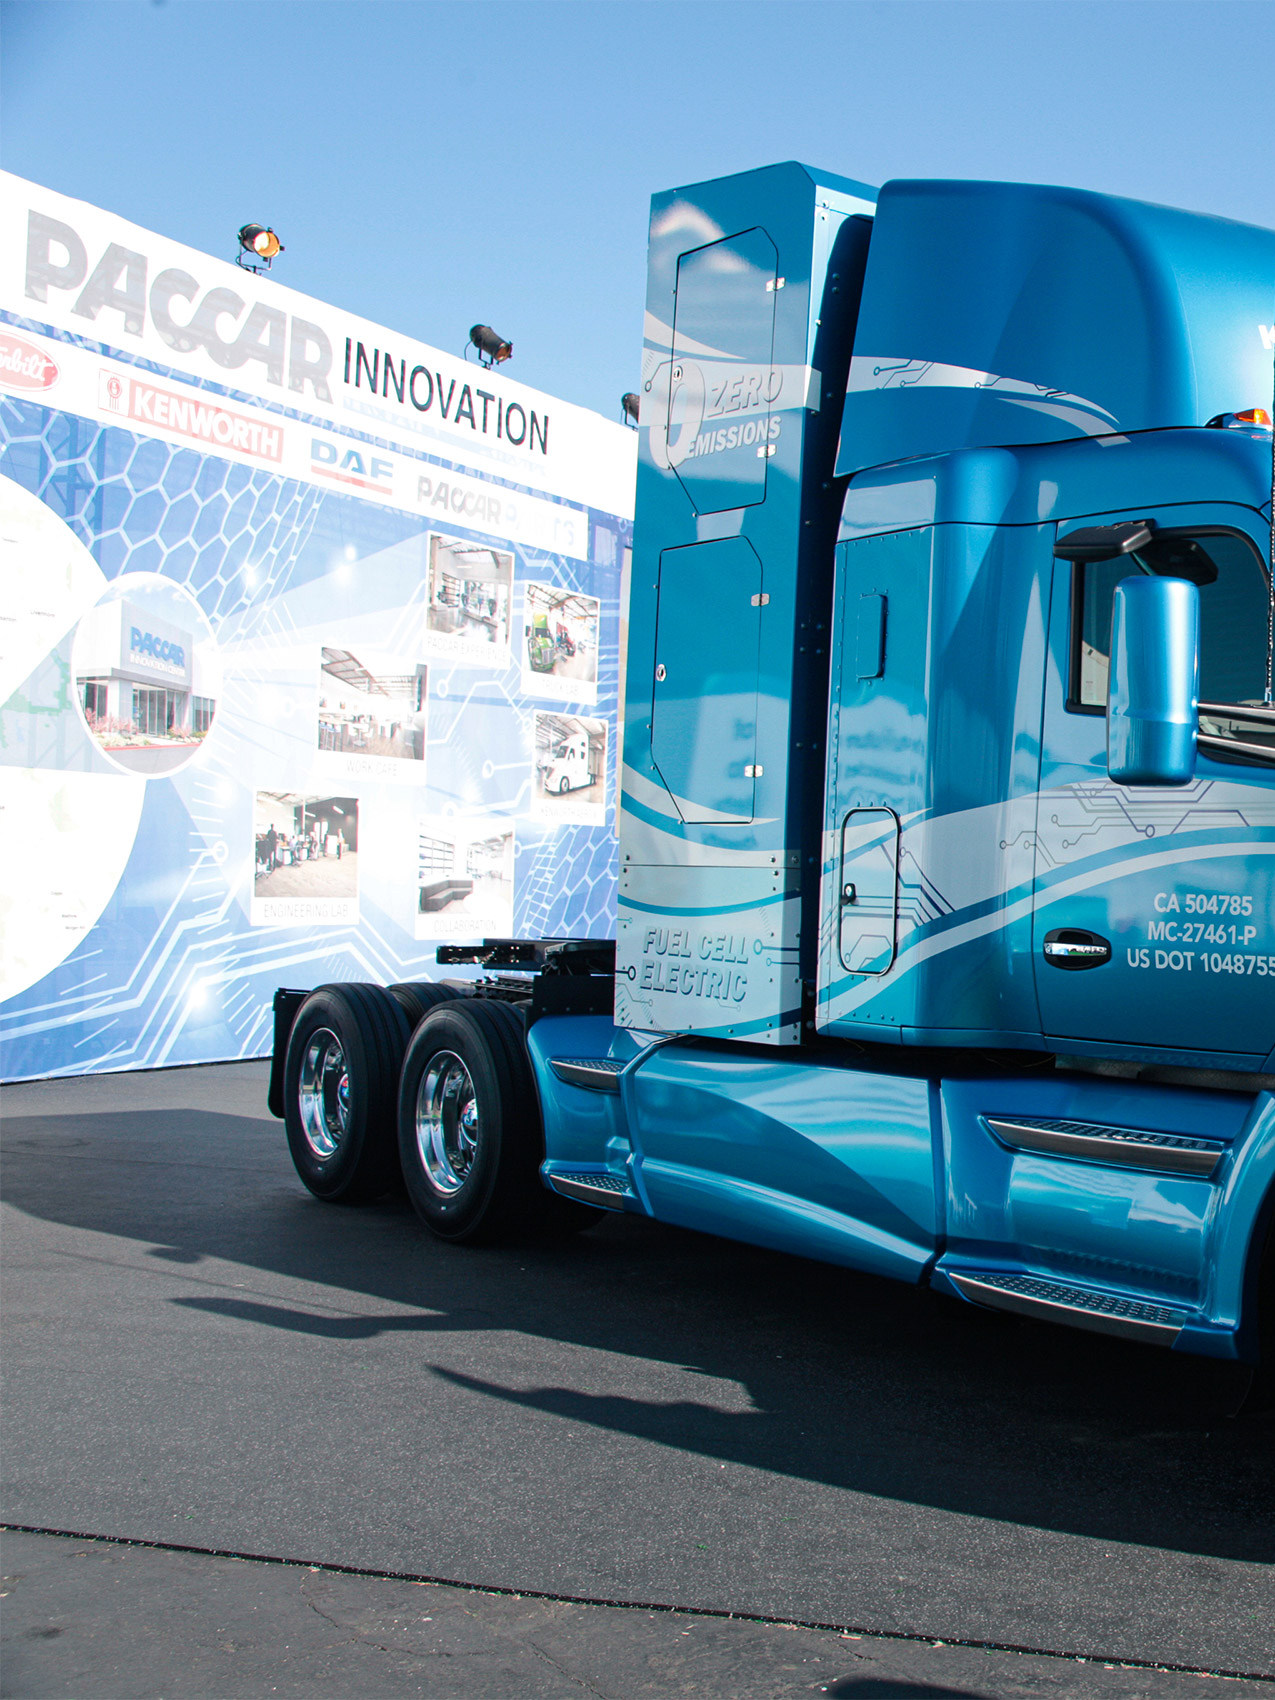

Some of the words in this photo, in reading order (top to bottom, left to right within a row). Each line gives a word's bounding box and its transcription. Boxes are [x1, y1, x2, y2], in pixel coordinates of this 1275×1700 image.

[24, 208, 335, 405] PACCAR
[343, 336, 550, 456] INNOVATION
[706, 367, 784, 418] ZERO
[134, 385, 281, 458] KENWORTH
[685, 415, 782, 459] EMISSIONS
[310, 438, 394, 480] DAF
[416, 474, 502, 526] PACCAR
[130, 626, 185, 668] PACCAR
[346, 759, 374, 775] WORK
[264, 903, 329, 919] ENGINEERING
[330, 904, 349, 918] LAB
[1153, 892, 1181, 914] CA
[1184, 894, 1253, 917] 504785
[433, 919, 498, 933] COLLABORATION
[643, 926, 692, 958] FUEL
[700, 931, 749, 964] CELL
[1147, 920, 1257, 946] MC-27461-P
[640, 958, 748, 1003] ELECTRIC
[1126, 947, 1151, 969] US
[1154, 950, 1195, 972] DOT
